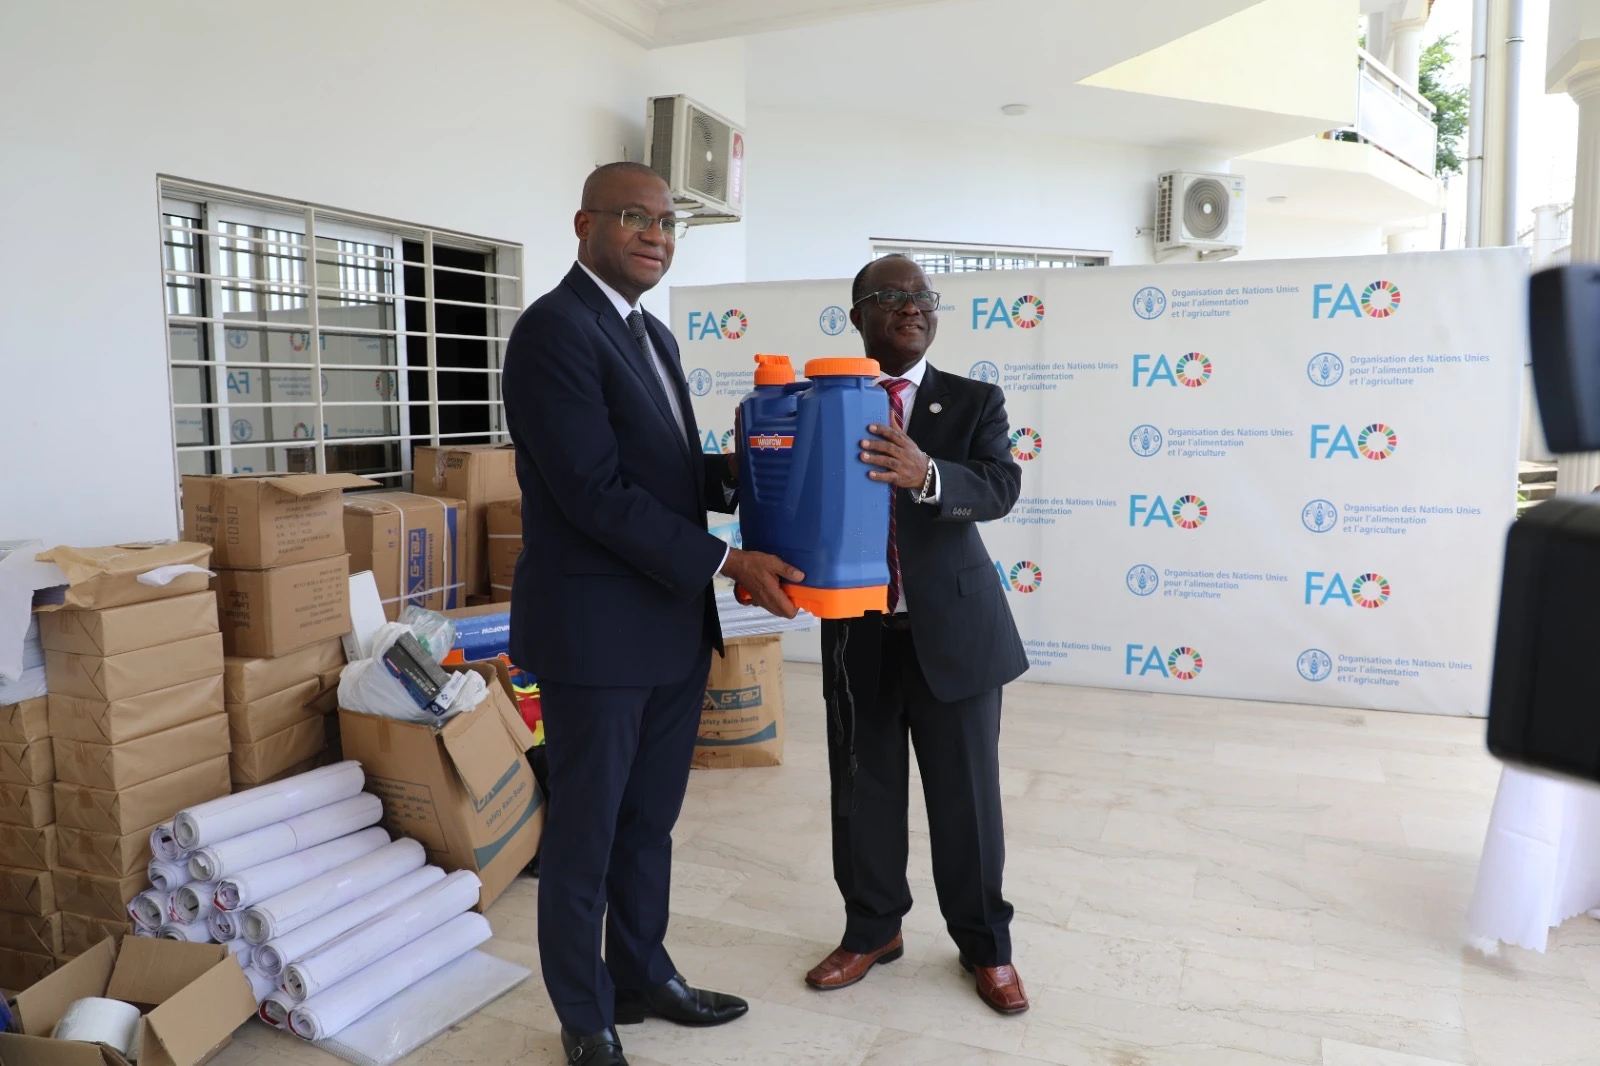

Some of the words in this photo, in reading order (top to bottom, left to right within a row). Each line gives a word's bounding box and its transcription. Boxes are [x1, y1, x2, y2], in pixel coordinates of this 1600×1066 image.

[1172, 288, 1223, 298] Organisation
[1225, 287, 1239, 295] des
[1242, 286, 1273, 295] Nations
[1276, 285, 1299, 293] Unies
[1171, 300, 1190, 308] pour
[1192, 298, 1249, 307] l'alimentation
[1313, 280, 1400, 319] FAO
[972, 295, 1044, 329] FAO
[1171, 310, 1180, 318] et
[1182, 309, 1230, 319] l'agriculture
[688, 309, 747, 340] FAO
[1350, 355, 1406, 365] Organisation
[1409, 354, 1424, 363] des
[1427, 354, 1461, 363] Nations
[1464, 354, 1490, 362] Unies
[1004, 362, 1051, 373] Organisation
[1052, 362, 1065, 370] des
[1067, 362, 1096, 370] Nations
[1098, 362, 1118, 370] Unies
[1132, 352, 1212, 388] FAO
[1350, 367, 1369, 376] pour
[1372, 366, 1434, 374] l'alimentation
[1023, 373, 1074, 381] l'alimentation
[1361, 377, 1414, 387] l'agriculture
[1013, 383, 1057, 391] l'agriculture
[1168, 427, 1218, 438] Organisation
[1221, 427, 1235, 436] des
[1237, 428, 1268, 436] Nations
[1271, 428, 1294, 436] Unies
[1167, 440, 1186, 448] pour
[1188, 438, 1244, 447] l'alimentation
[1310, 423, 1397, 461] FAO
[1178, 448, 1226, 458] l'agriculture
[1016, 497, 1049, 505] anisation
[1066, 498, 1094, 506] Nations
[1096, 499, 1117, 507] Unies
[1129, 494, 1208, 529] FAO
[1343, 503, 1399, 513] Organisation
[1401, 504, 1416, 513] des
[1419, 505, 1453, 514] Nations
[1456, 506, 1481, 515] Unies
[1343, 515, 1362, 524] pour
[1366, 515, 1427, 524] l'alimentation
[1354, 525, 1406, 535] l'agriculture
[1164, 569, 1214, 578] Organisation
[1216, 571, 1230, 579] des
[1232, 571, 1263, 581] Nations
[1265, 573, 1288, 582] Unies
[1164, 580, 1182, 588] pour
[1184, 580, 1239, 589] l'alimentation
[1304, 571, 1391, 609] FAO
[1174, 589, 1221, 599] l'agriculture
[1047, 640, 1059, 648] des
[1062, 641, 1089, 650] Nations
[1025, 649, 1068, 658] limentation
[1125, 644, 1203, 680] FAO
[1338, 654, 1392, 665] Organisation
[1394, 657, 1410, 666] des
[1412, 659, 1446, 669] Nations
[1448, 661, 1472, 670] Unies
[1338, 665, 1357, 673] pour
[1359, 665, 1419, 677] l'alimentation
[1348, 674, 1399, 686] l'agriculture
